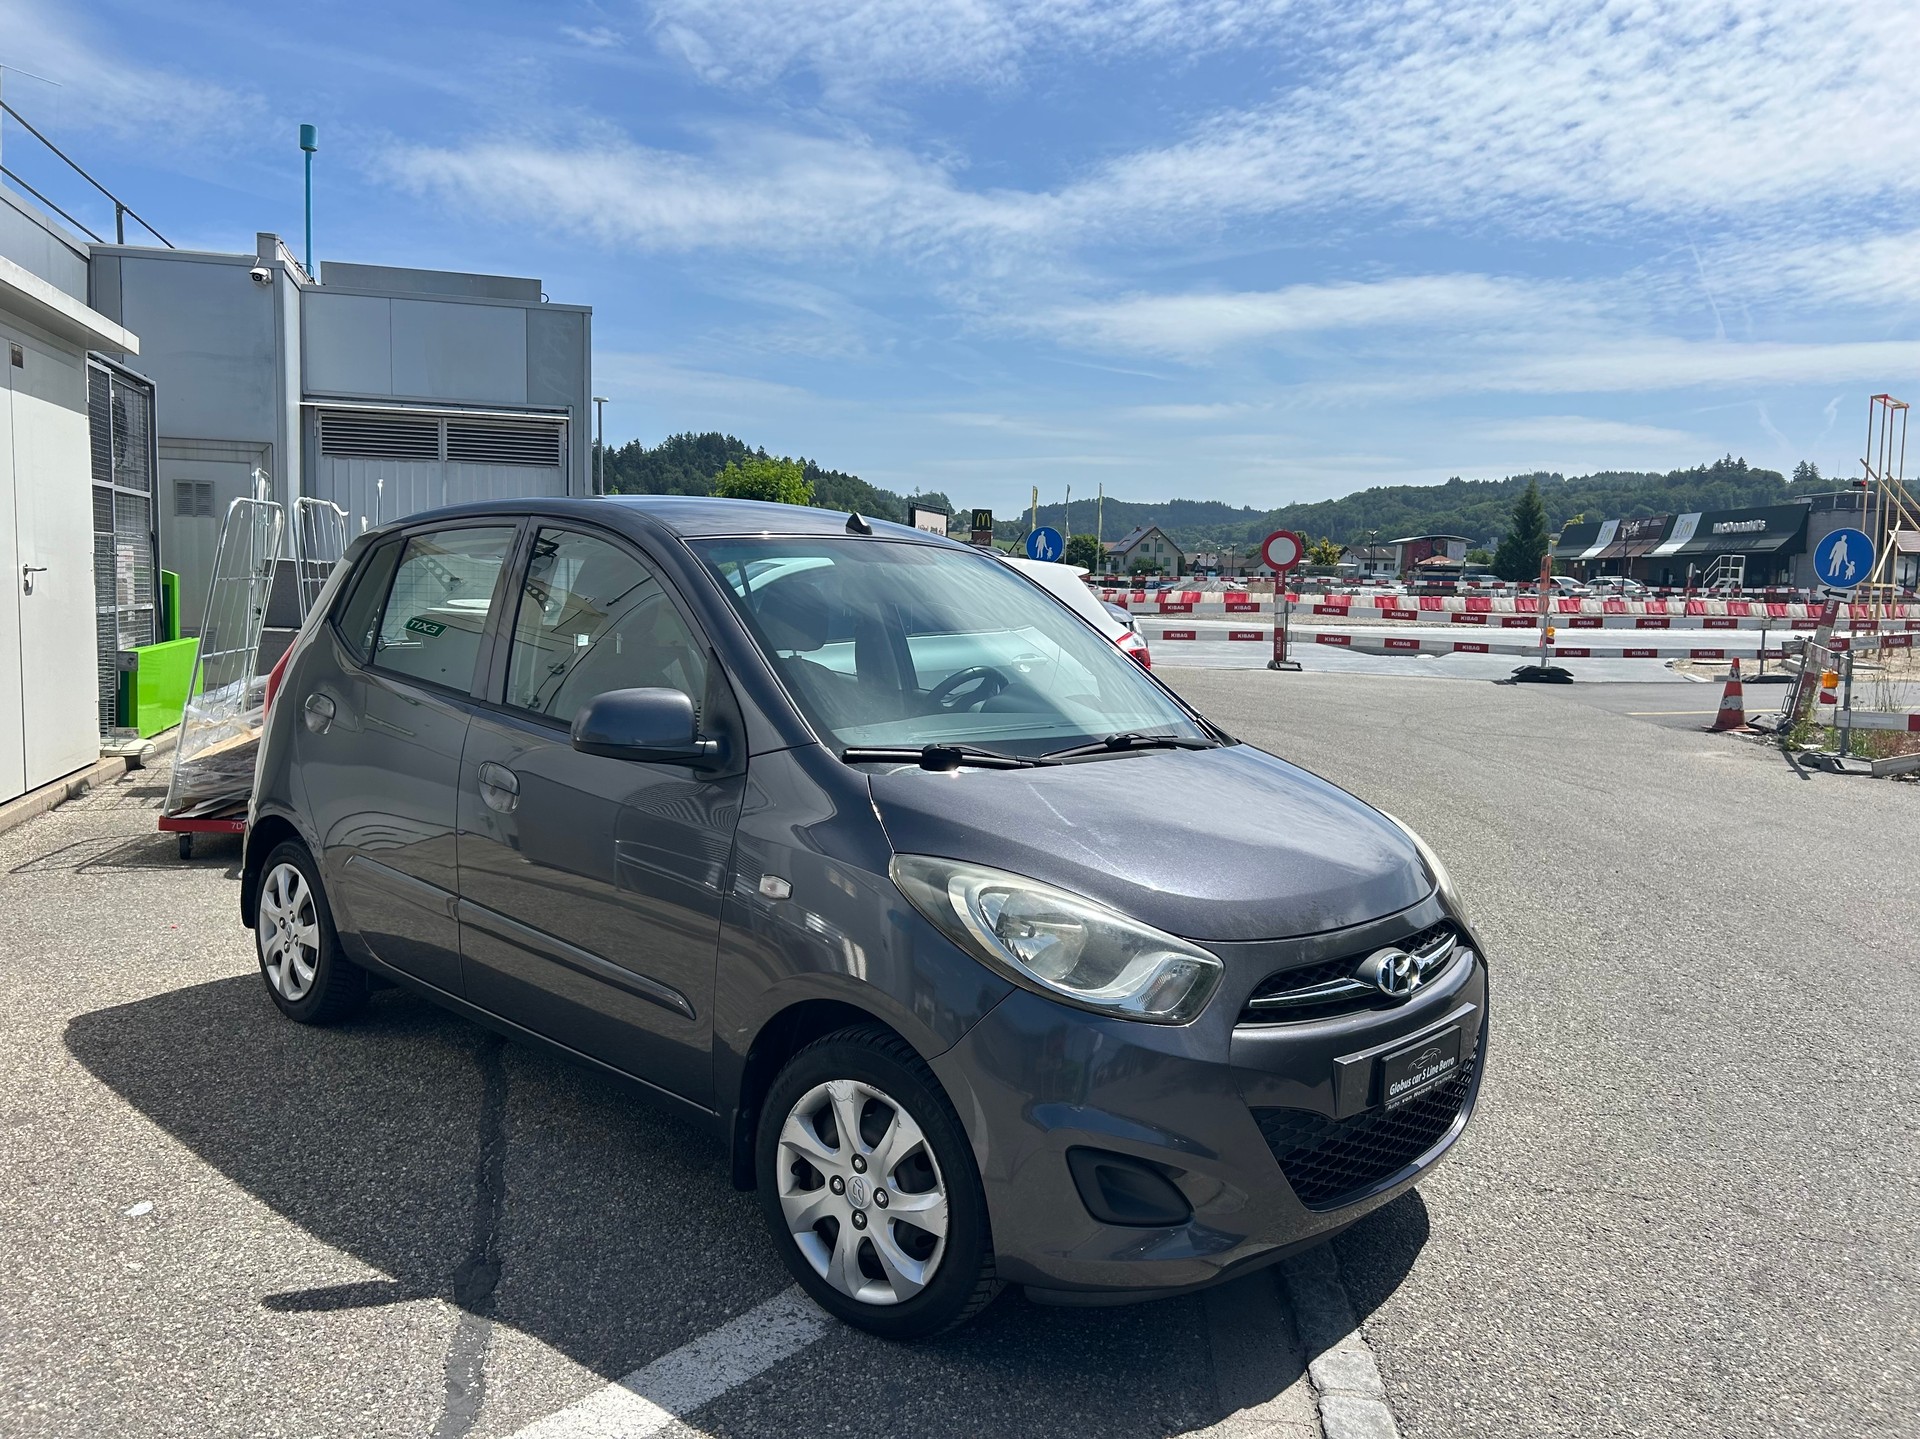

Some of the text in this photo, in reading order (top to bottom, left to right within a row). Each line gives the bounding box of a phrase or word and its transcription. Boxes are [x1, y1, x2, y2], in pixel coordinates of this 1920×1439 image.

[1888, 637, 1905, 645] KIBAG
[1389, 1078, 1412, 1096] Globus
[1411, 1073, 1422, 1085] car
[1421, 1068, 1427, 1080] S
[1426, 1064, 1439, 1078] Line
